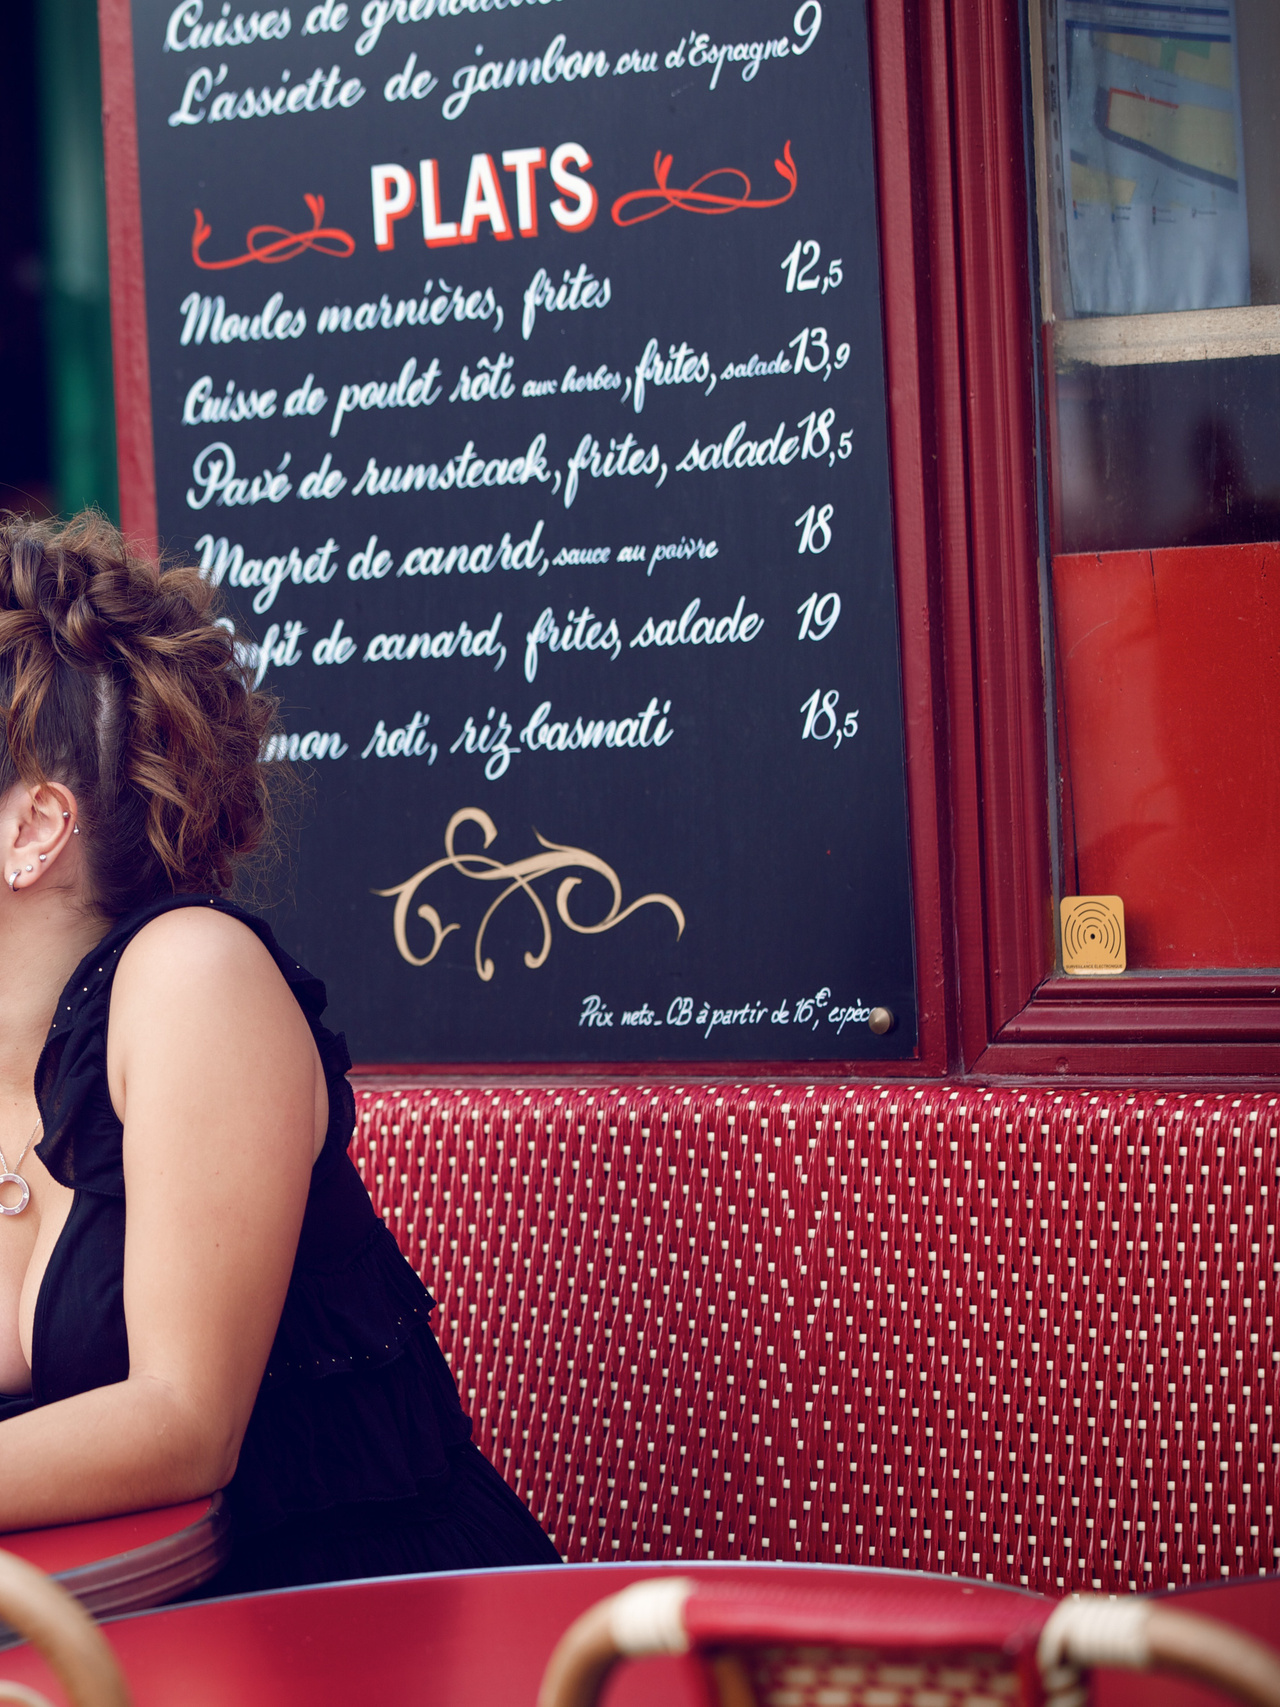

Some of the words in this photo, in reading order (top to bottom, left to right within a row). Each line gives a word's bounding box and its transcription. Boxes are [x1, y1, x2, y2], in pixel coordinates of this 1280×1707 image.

[163, 0, 292, 52] Cuisses
[301, 0, 350, 36] de
[167, 63, 367, 127] L'assiette
[383, 52, 439, 102] de
[441, 33, 611, 121] jambon
[612, 48, 659, 76] cru
[664, 29, 791, 91] d'Espagne
[791, 0, 823, 56] 9
[370, 141, 600, 252] PLATS
[179, 291, 307, 346] Moules
[521, 263, 612, 341] frites
[780, 239, 846, 296] 12,5
[181, 375, 278, 426] Cuisse
[282, 373, 328, 417] de
[329, 356, 443, 438] poulet
[448, 352, 516, 403] rôti
[521, 379, 558, 398] aux
[633, 337, 717, 414] frites,
[719, 349, 793, 381] salade
[788, 326, 852, 382] 13,9
[186, 441, 293, 510] Pavé
[297, 452, 348, 500] de
[563, 432, 668, 509] frites,
[675, 420, 801, 472] salade
[797, 407, 855, 468] 18,5
[194, 533, 340, 615] Magret
[347, 534, 394, 581] de
[396, 519, 551, 577] canard,
[551, 546, 611, 567] sauce
[616, 544, 646, 563] au
[646, 536, 720, 577] poivre
[794, 503, 834, 554] 18
[312, 618, 358, 666] de
[363, 612, 507, 672] canard,
[524, 606, 622, 683] frites,
[629, 595, 767, 649] salade
[796, 591, 842, 642] 19
[449, 706, 522, 781] riz
[519, 697, 675, 751] basmati
[800, 688, 860, 750] 18,5
[578, 994, 614, 1028] Prix
[666, 996, 694, 1027] CB
[695, 1001, 711, 1025] à
[704, 1000, 769, 1040] partir
[770, 998, 790, 1025] de
[827, 997, 877, 1036] espèc
